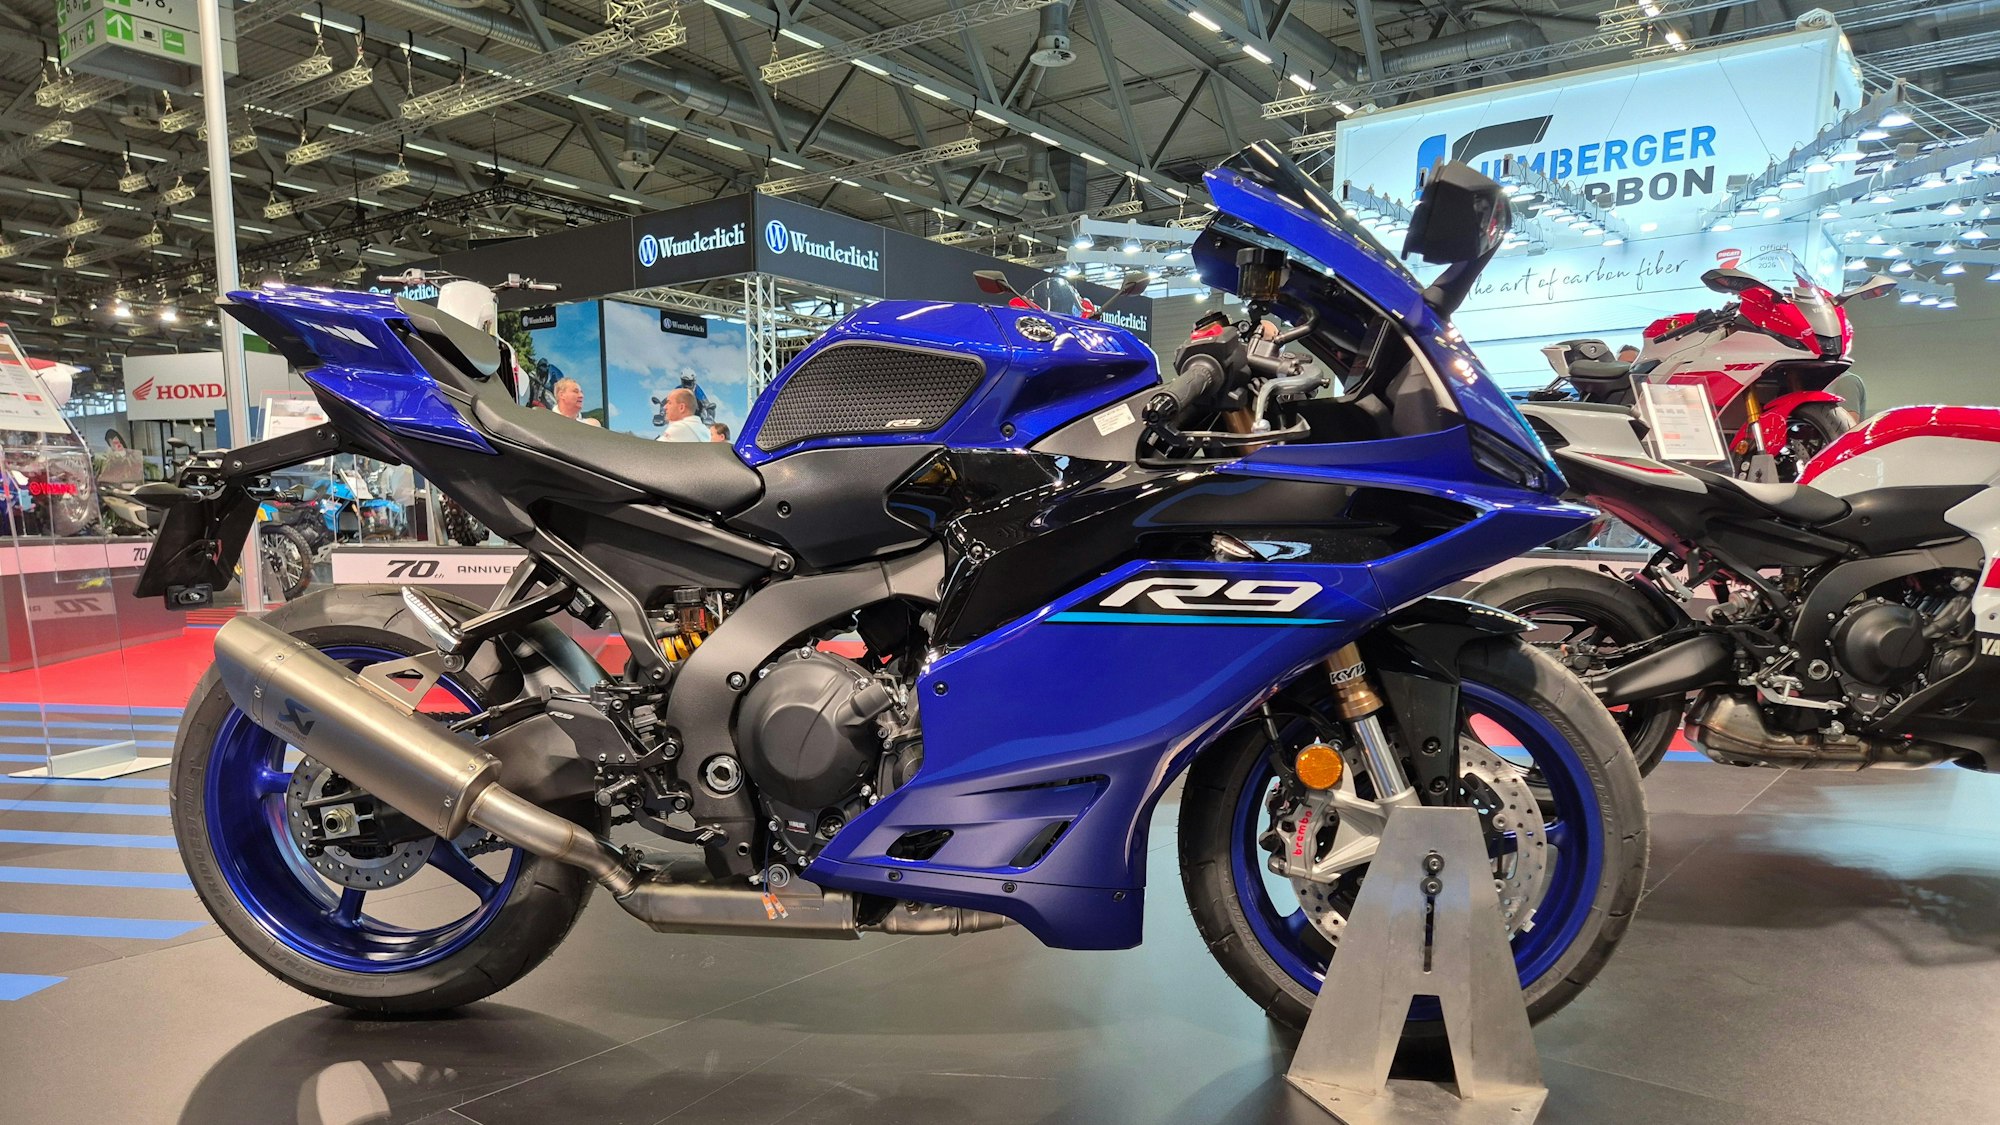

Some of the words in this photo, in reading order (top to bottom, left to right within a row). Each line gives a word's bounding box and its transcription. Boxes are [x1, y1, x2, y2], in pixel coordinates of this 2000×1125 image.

[659, 223, 746, 258] Wunderlich
[790, 230, 879, 271] Wunderlich
[1500, 267, 1538, 294] art
[1539, 268, 1558, 300] of
[1563, 257, 1630, 284] carbon
[1636, 250, 1688, 290] fiber
[1094, 305, 1147, 331] underlich
[155, 383, 226, 400] HOND
[885, 418, 922, 428] R9
[1099, 577, 1323, 612] R9
[1292, 810, 1313, 856] brembo
